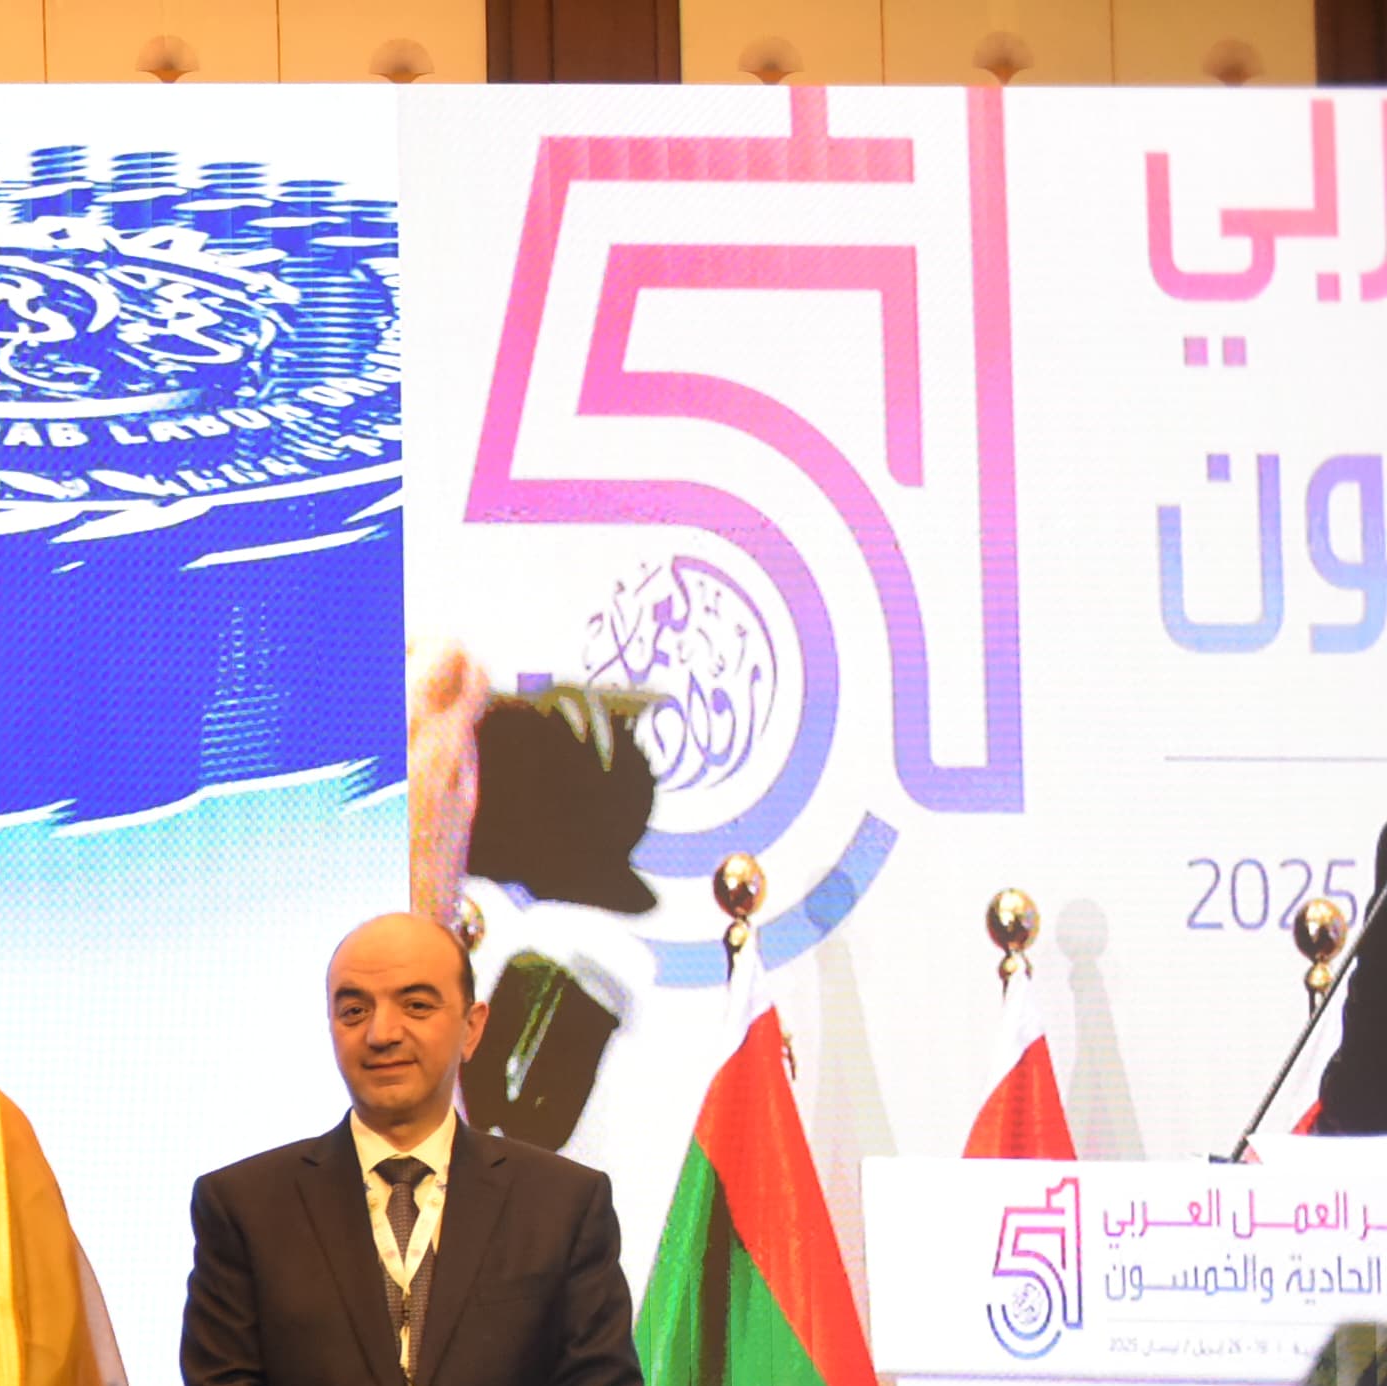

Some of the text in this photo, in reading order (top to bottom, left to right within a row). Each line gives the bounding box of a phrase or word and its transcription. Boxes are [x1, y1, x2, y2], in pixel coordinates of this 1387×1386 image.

[1103, 1187, 1221, 1250] العربي
[1232, 1188, 1348, 1240] العمل
[1104, 1252, 1274, 1304] والخمسون
[1285, 1253, 1382, 1306] الحادية
